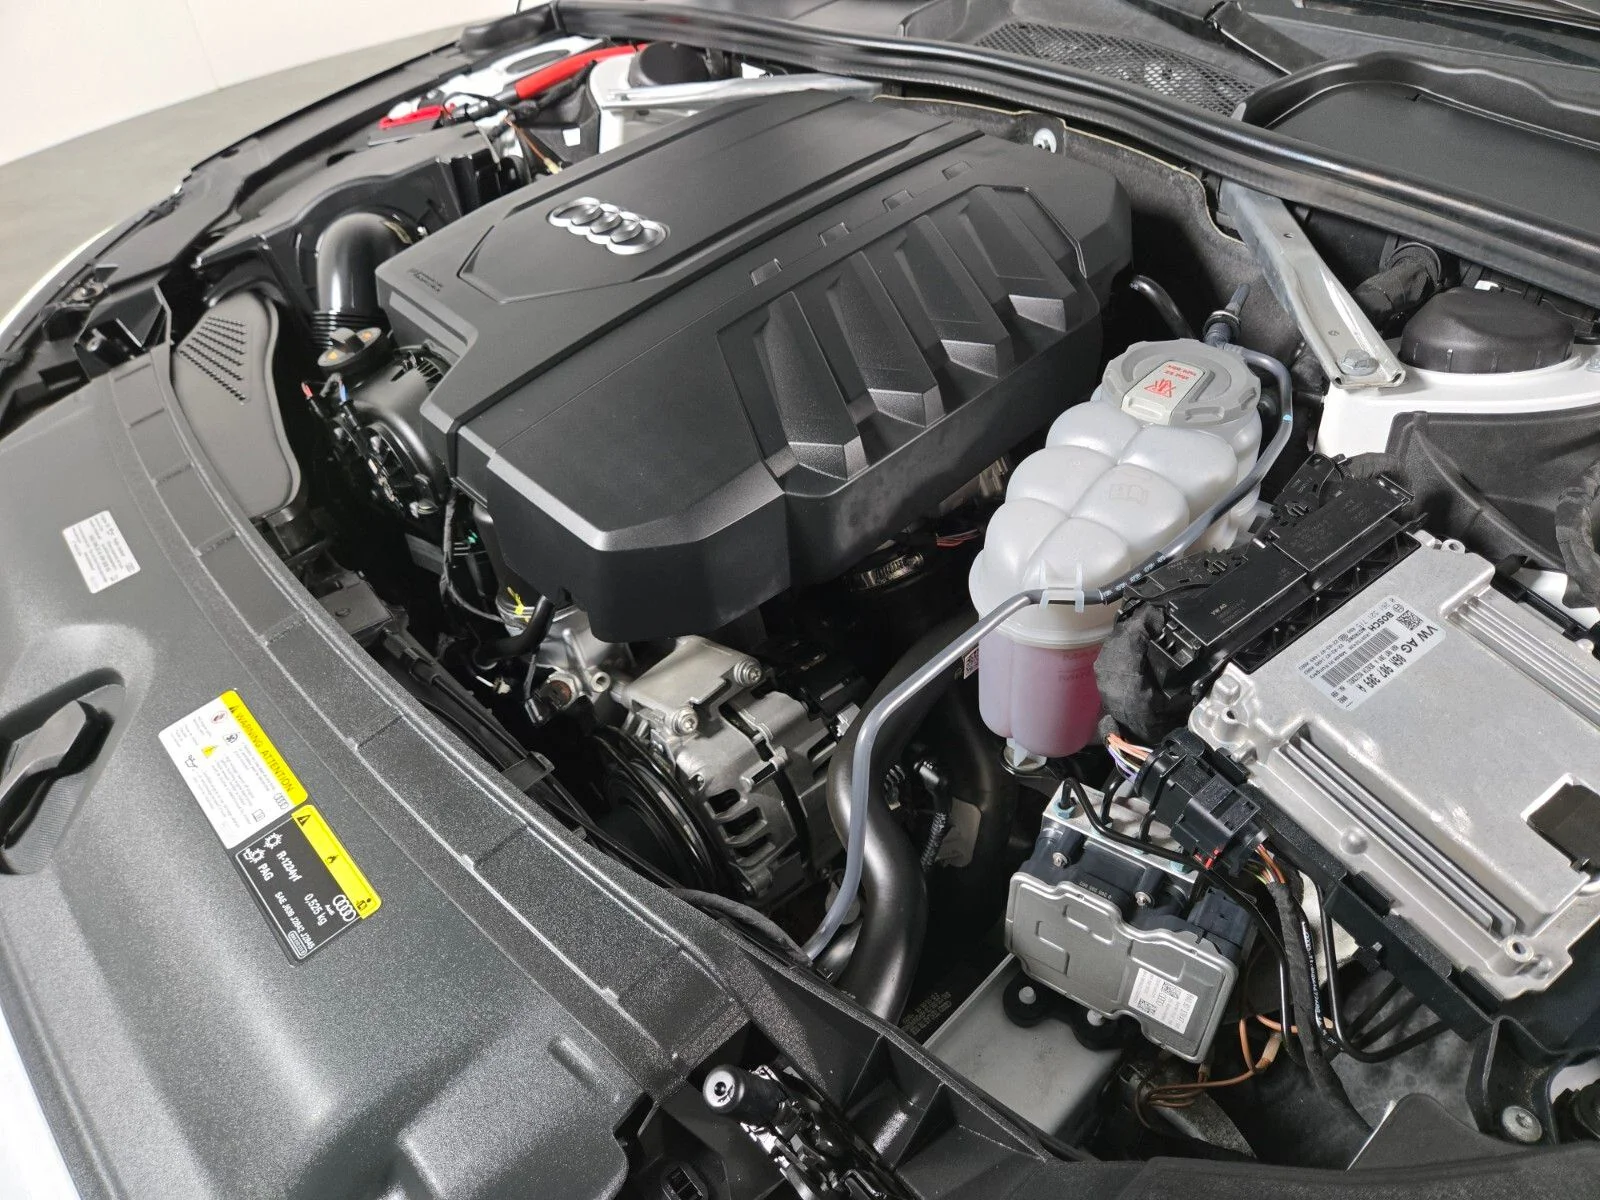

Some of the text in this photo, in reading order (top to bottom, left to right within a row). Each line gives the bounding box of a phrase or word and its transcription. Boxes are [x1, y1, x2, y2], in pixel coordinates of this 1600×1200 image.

[1368, 611, 1394, 631] BOSCH
[1417, 625, 1438, 641] VW
[1400, 638, 1418, 653] AG
[1379, 664, 1394, 678] 907
[1363, 674, 1380, 688] 309
[236, 712, 263, 748] WARNING
[262, 750, 294, 792] ATTENTION
[257, 863, 274, 881] PAG
[304, 893, 327, 926] 0,525 kg
[325, 904, 335, 916] Audi
